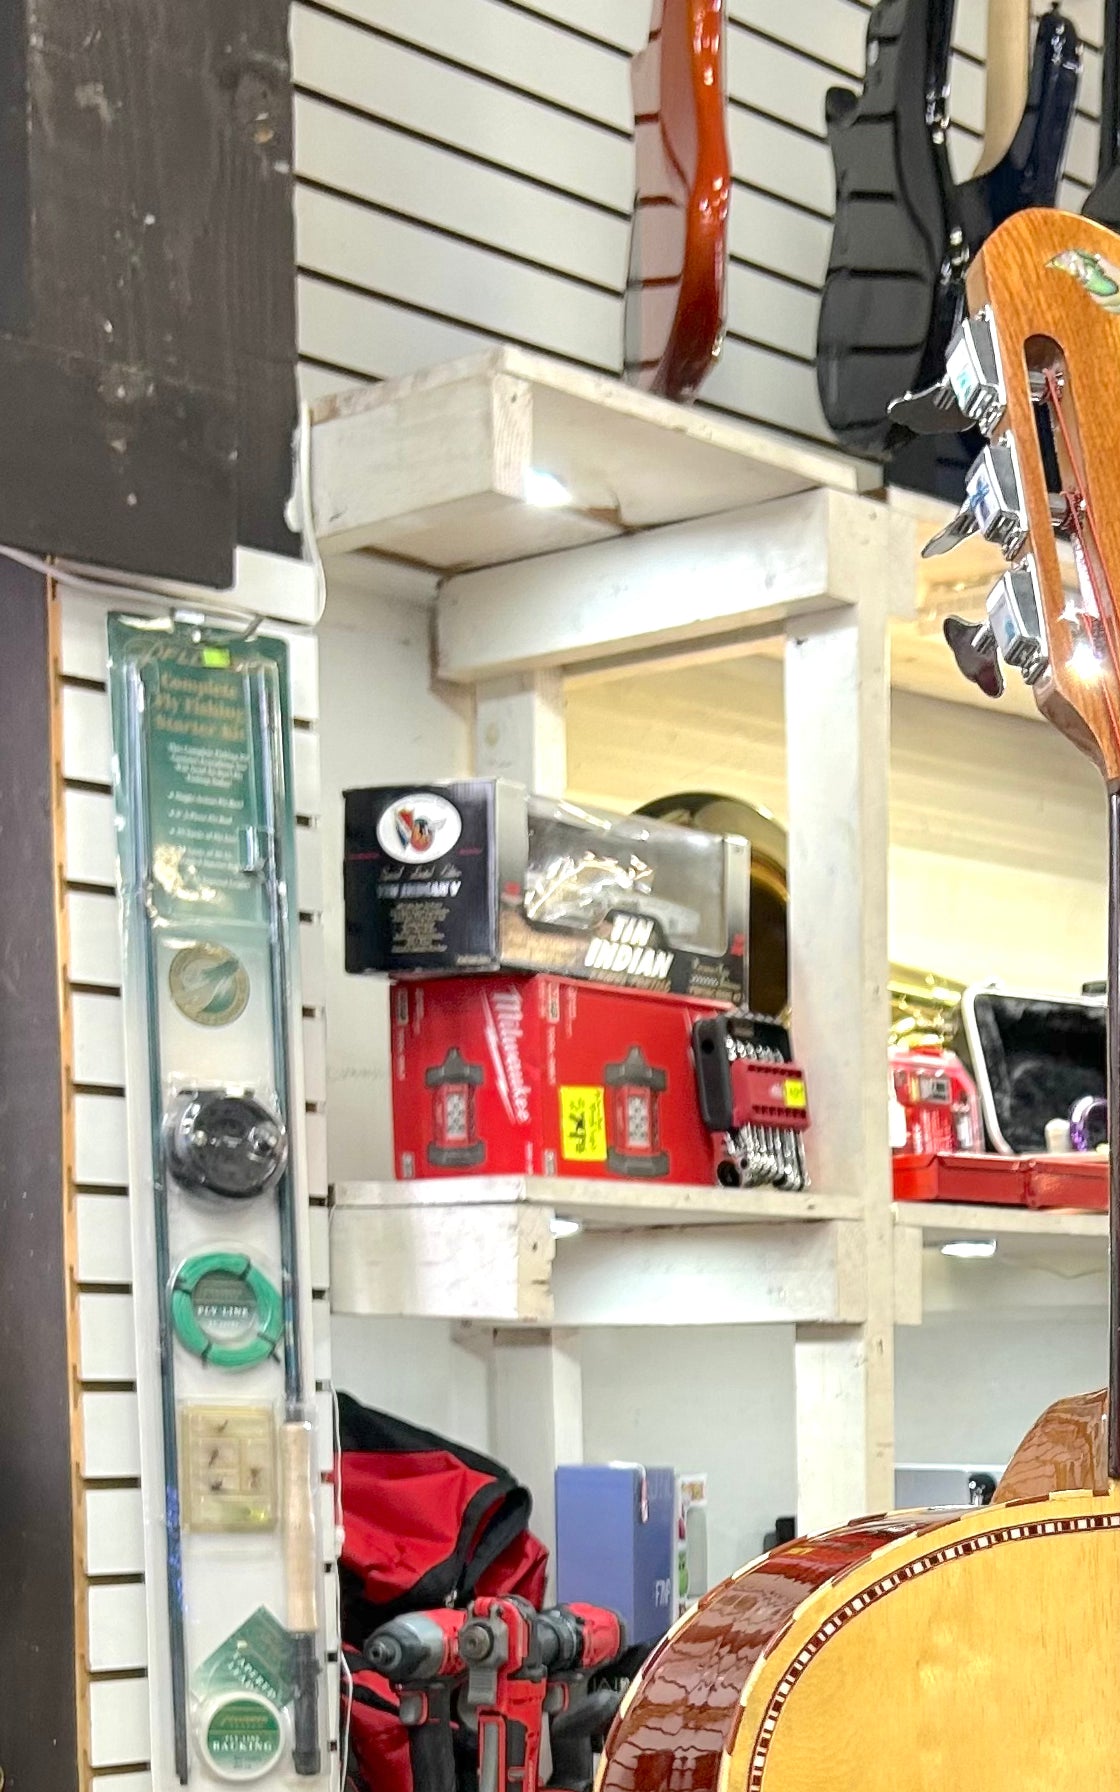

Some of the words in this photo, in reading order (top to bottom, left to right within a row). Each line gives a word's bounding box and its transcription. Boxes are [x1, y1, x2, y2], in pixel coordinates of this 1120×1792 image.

[610, 914, 654, 947] TIN
[584, 937, 674, 979] INDIAN
[492, 985, 531, 1123] Milwaukee
[197, 1305, 217, 1317] FLY
[222, 1306, 249, 1318] LINE
[212, 1740, 272, 1751] BACKING
